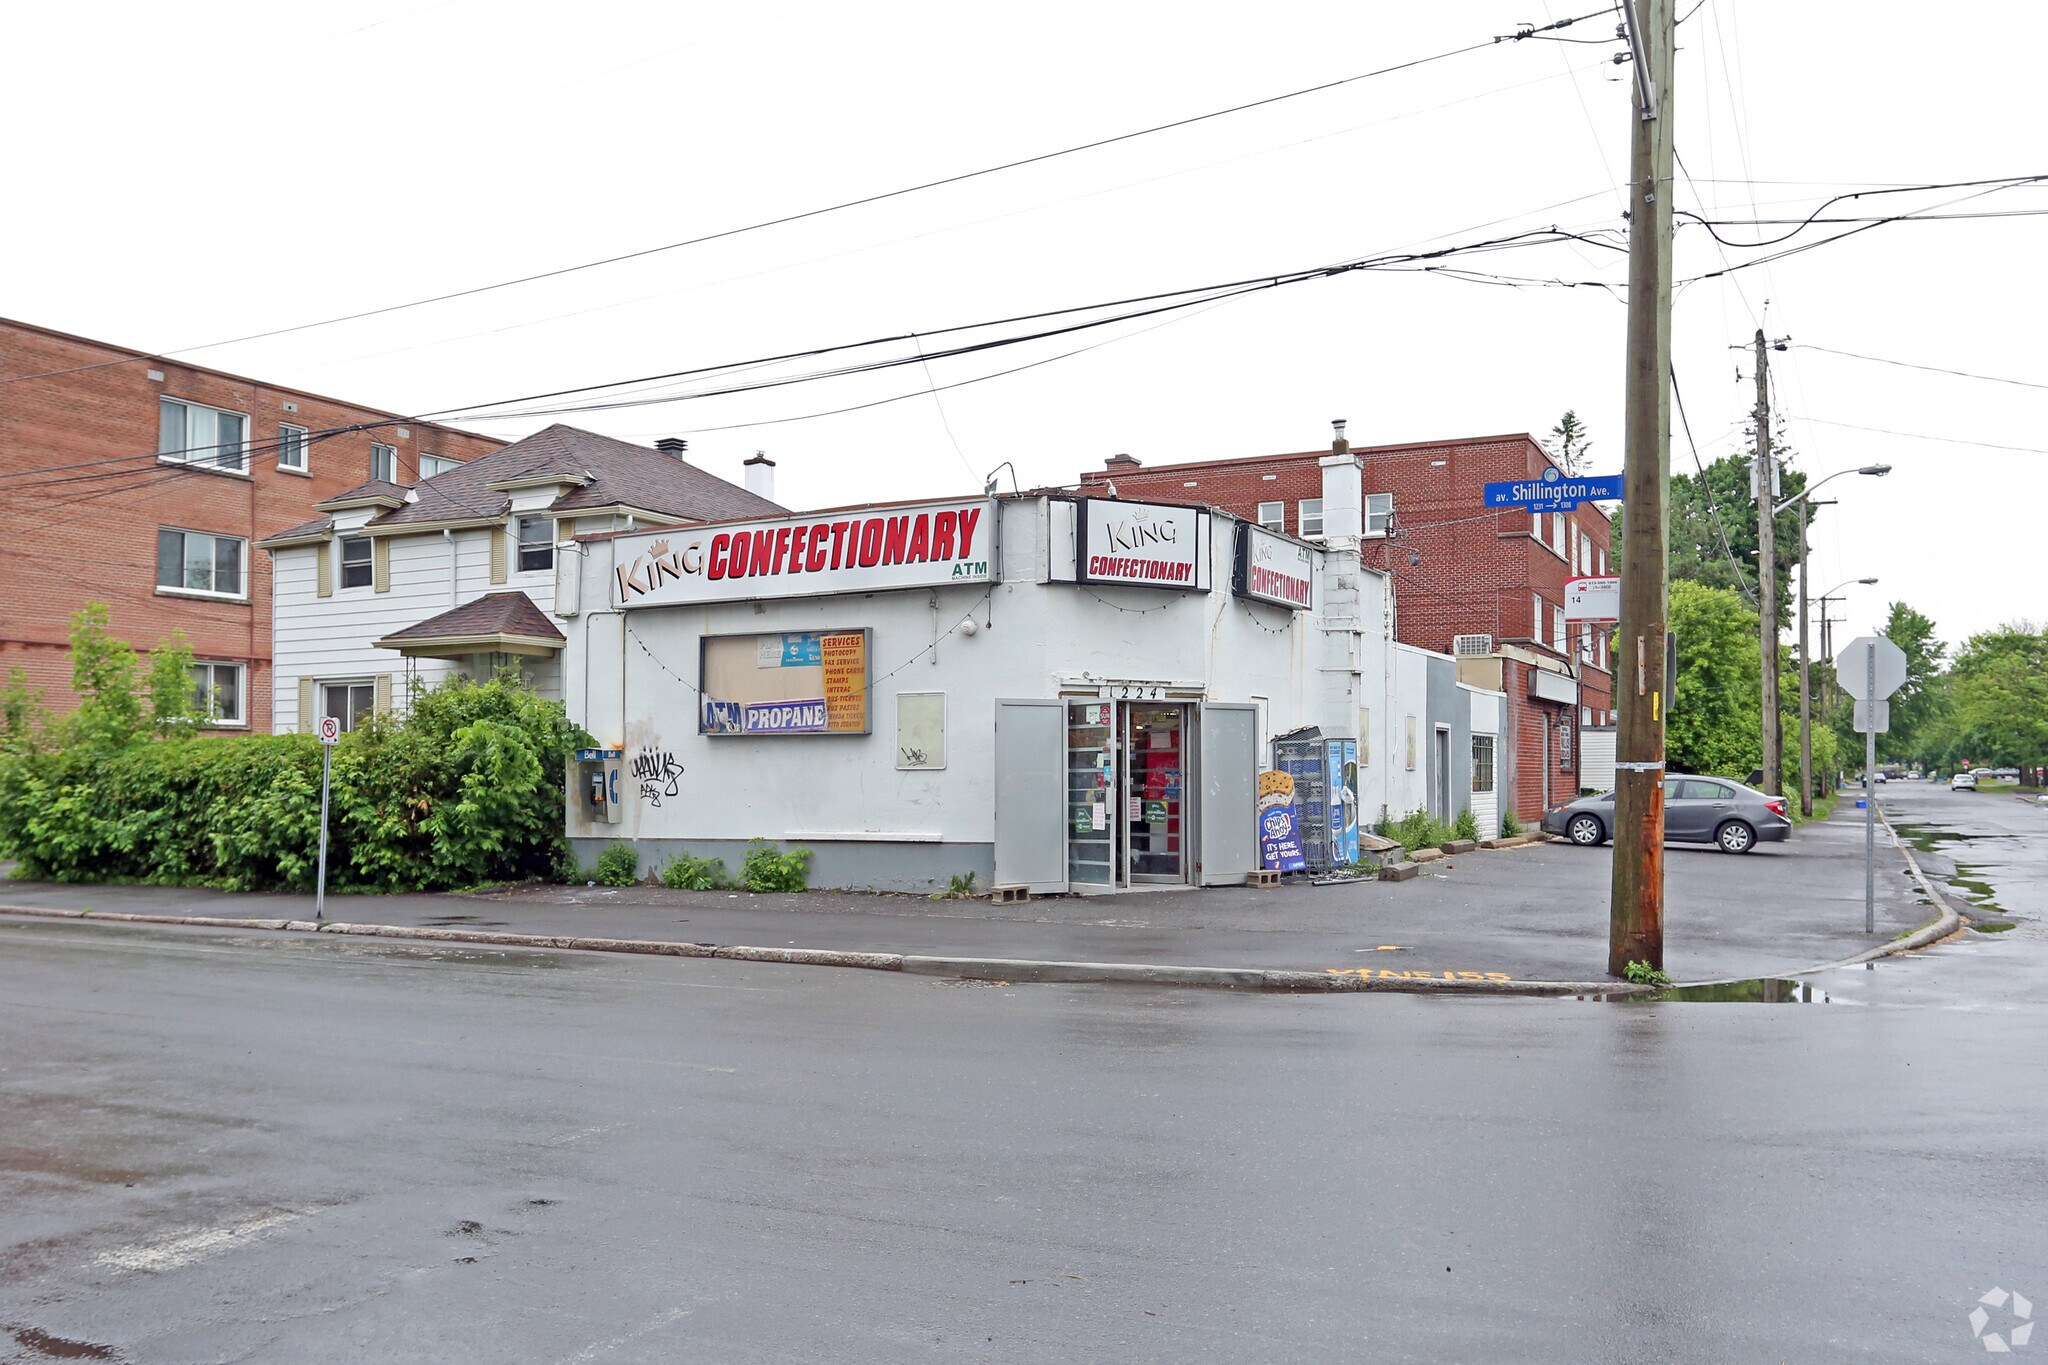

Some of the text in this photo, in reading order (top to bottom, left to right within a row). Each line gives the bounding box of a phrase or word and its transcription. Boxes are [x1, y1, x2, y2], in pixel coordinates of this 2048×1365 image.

[1495, 482, 1610, 503] av. Shillington Ave.
[707, 508, 981, 581] CONFECTIONARY
[952, 561, 987, 576] ATM
[1089, 555, 1193, 582] CONFECTIONARY
[1251, 565, 1310, 605] CONFECTIONARY
[822, 636, 860, 647] SERVICES
[823, 649, 857, 657] PHOTOCOPY
[836, 658, 860, 666] SERVICE
[747, 705, 824, 729] PROPANE
[584, 751, 597, 759] Bell
[1279, 841, 1297, 850] HERE.
[1265, 849, 1301, 860] GET YOURS.
